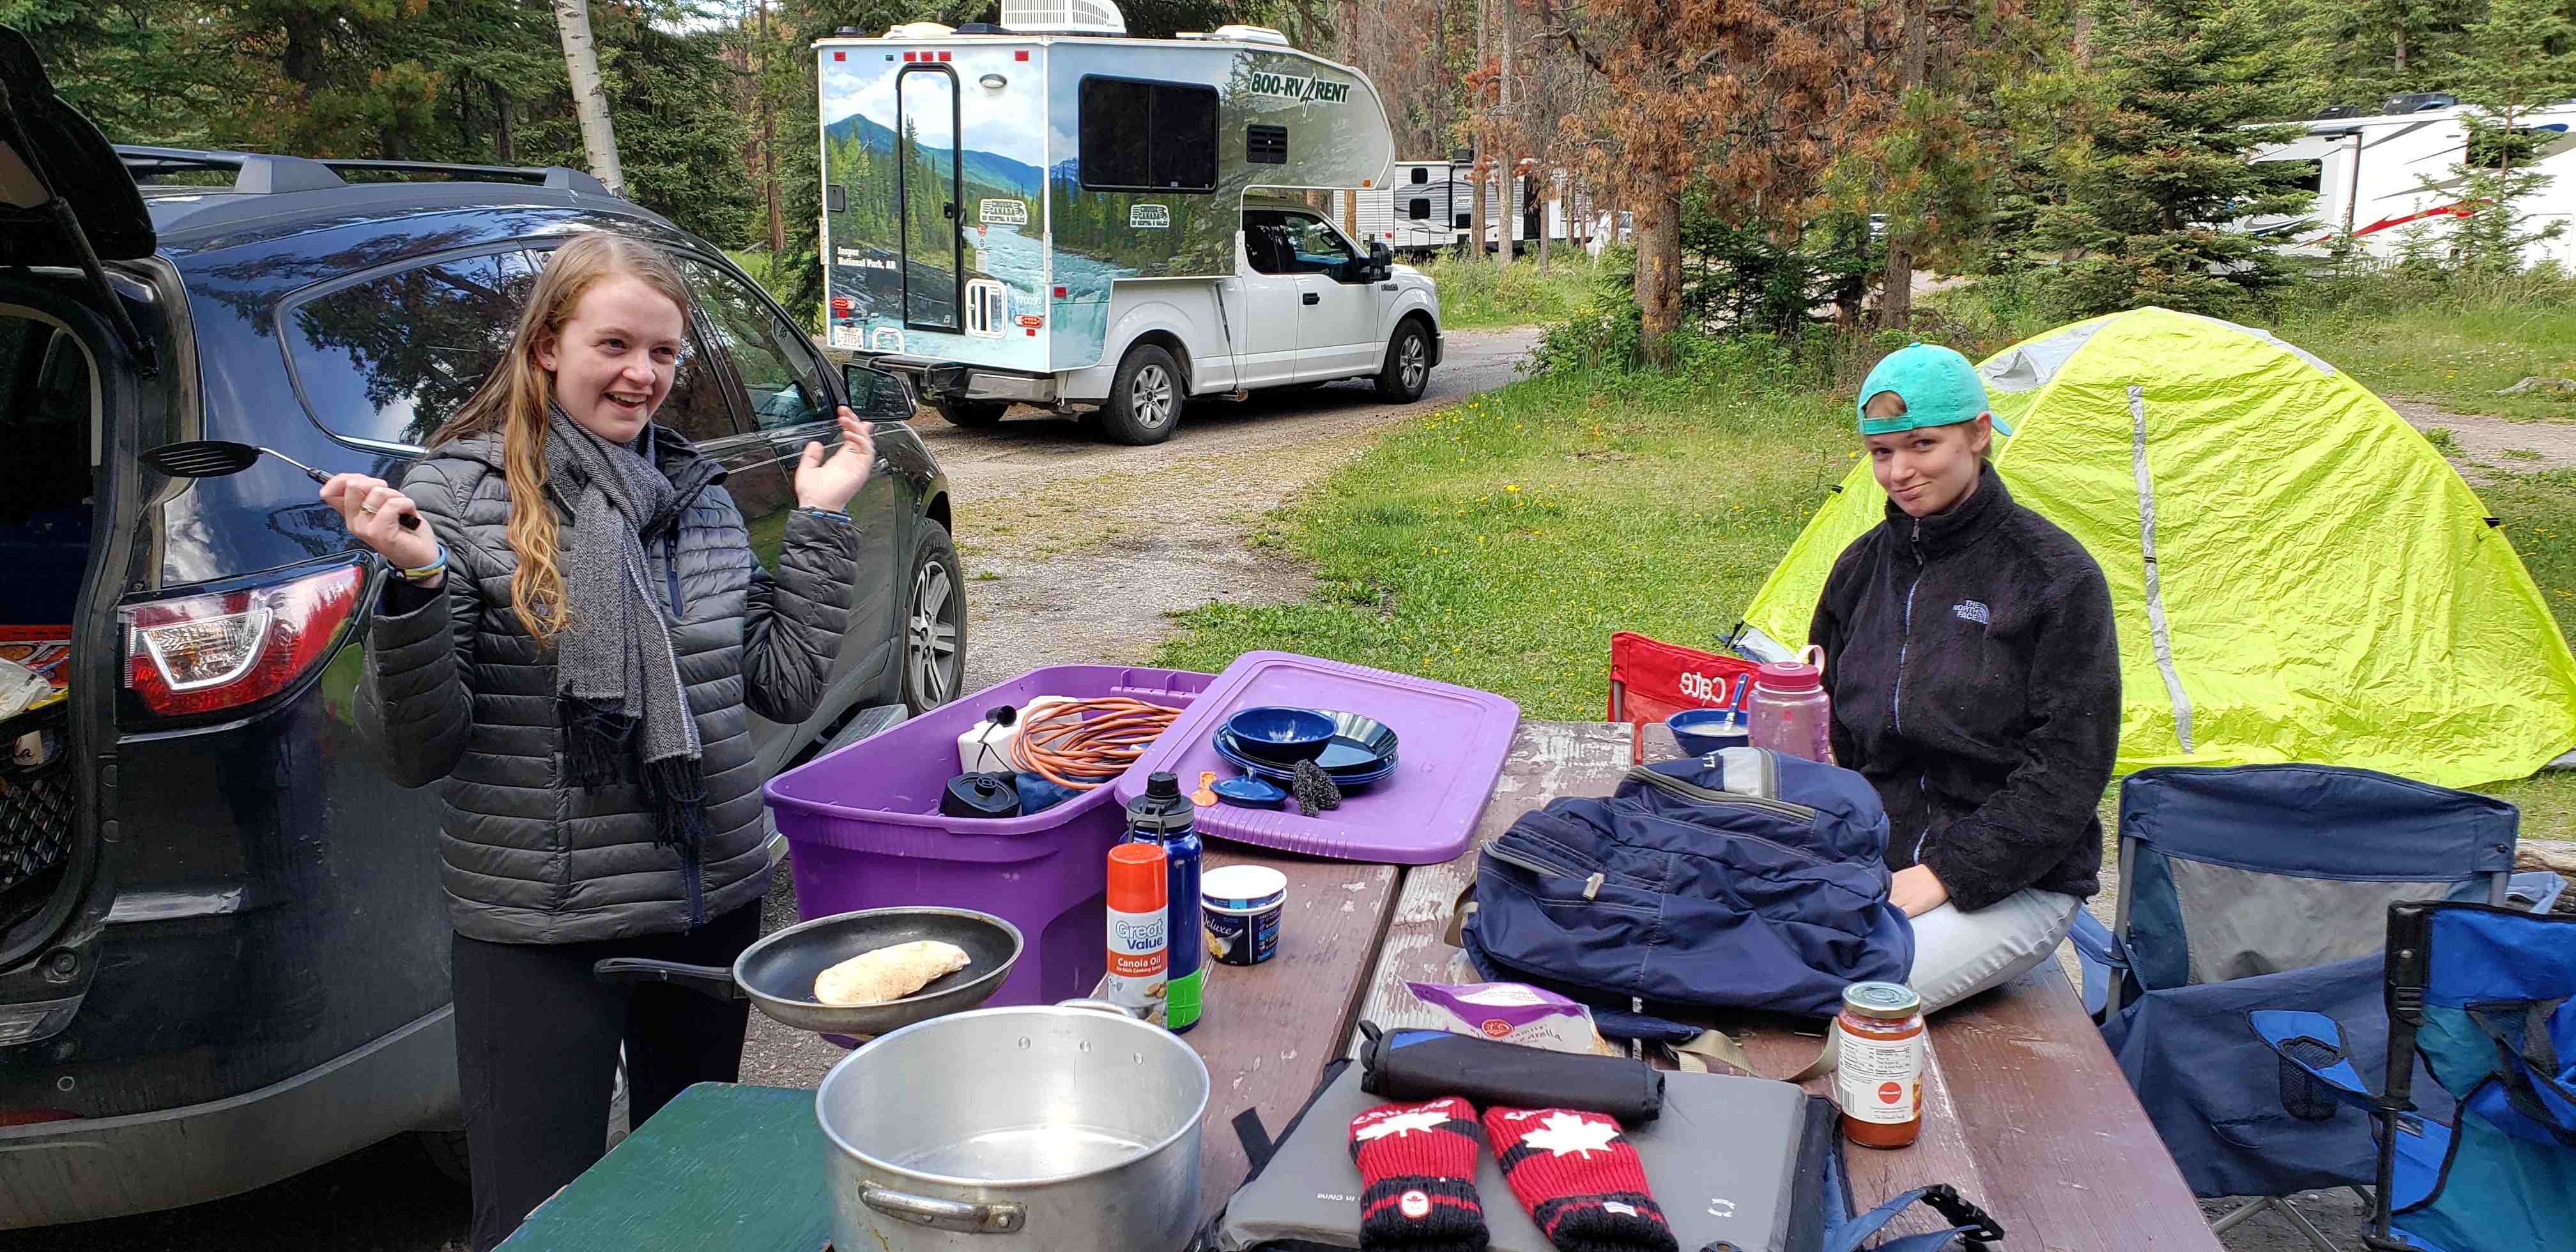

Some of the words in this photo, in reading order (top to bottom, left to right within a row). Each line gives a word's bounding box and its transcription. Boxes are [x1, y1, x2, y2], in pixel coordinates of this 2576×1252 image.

[837, 246, 859, 257] Jasper
[838, 257, 866, 267] National
[866, 259, 885, 269] Park,
[885, 261, 896, 269] AB
[1952, 604, 1979, 614] NORTH
[1965, 600, 1980, 609] THE
[1957, 611, 1978, 620] FACE
[1116, 918, 1164, 939] Great
[1127, 936, 1163, 950] Value
[1117, 958, 1148, 967] Canola
[1150, 954, 1161, 965] Oil
